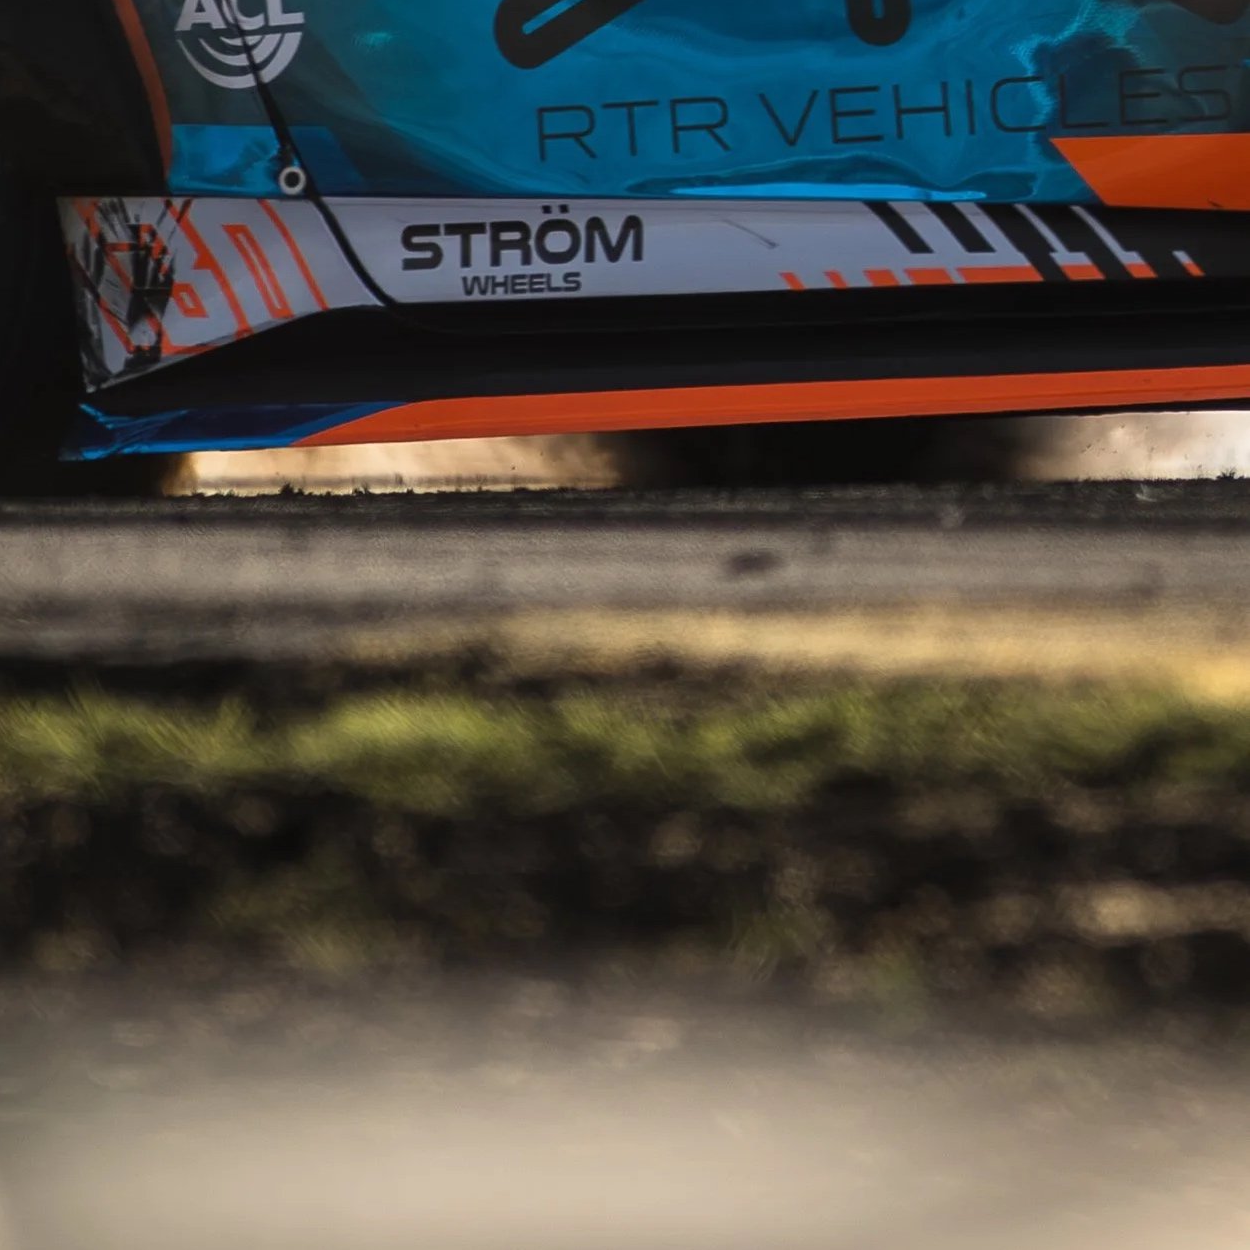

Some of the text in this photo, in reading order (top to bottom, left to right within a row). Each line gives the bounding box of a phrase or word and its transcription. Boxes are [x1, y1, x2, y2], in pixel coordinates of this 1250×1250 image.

[536, 65, 1232, 162] RTR VEHICLES
[401, 204, 644, 271] STRÖM
[461, 271, 582, 296] WHEELS
